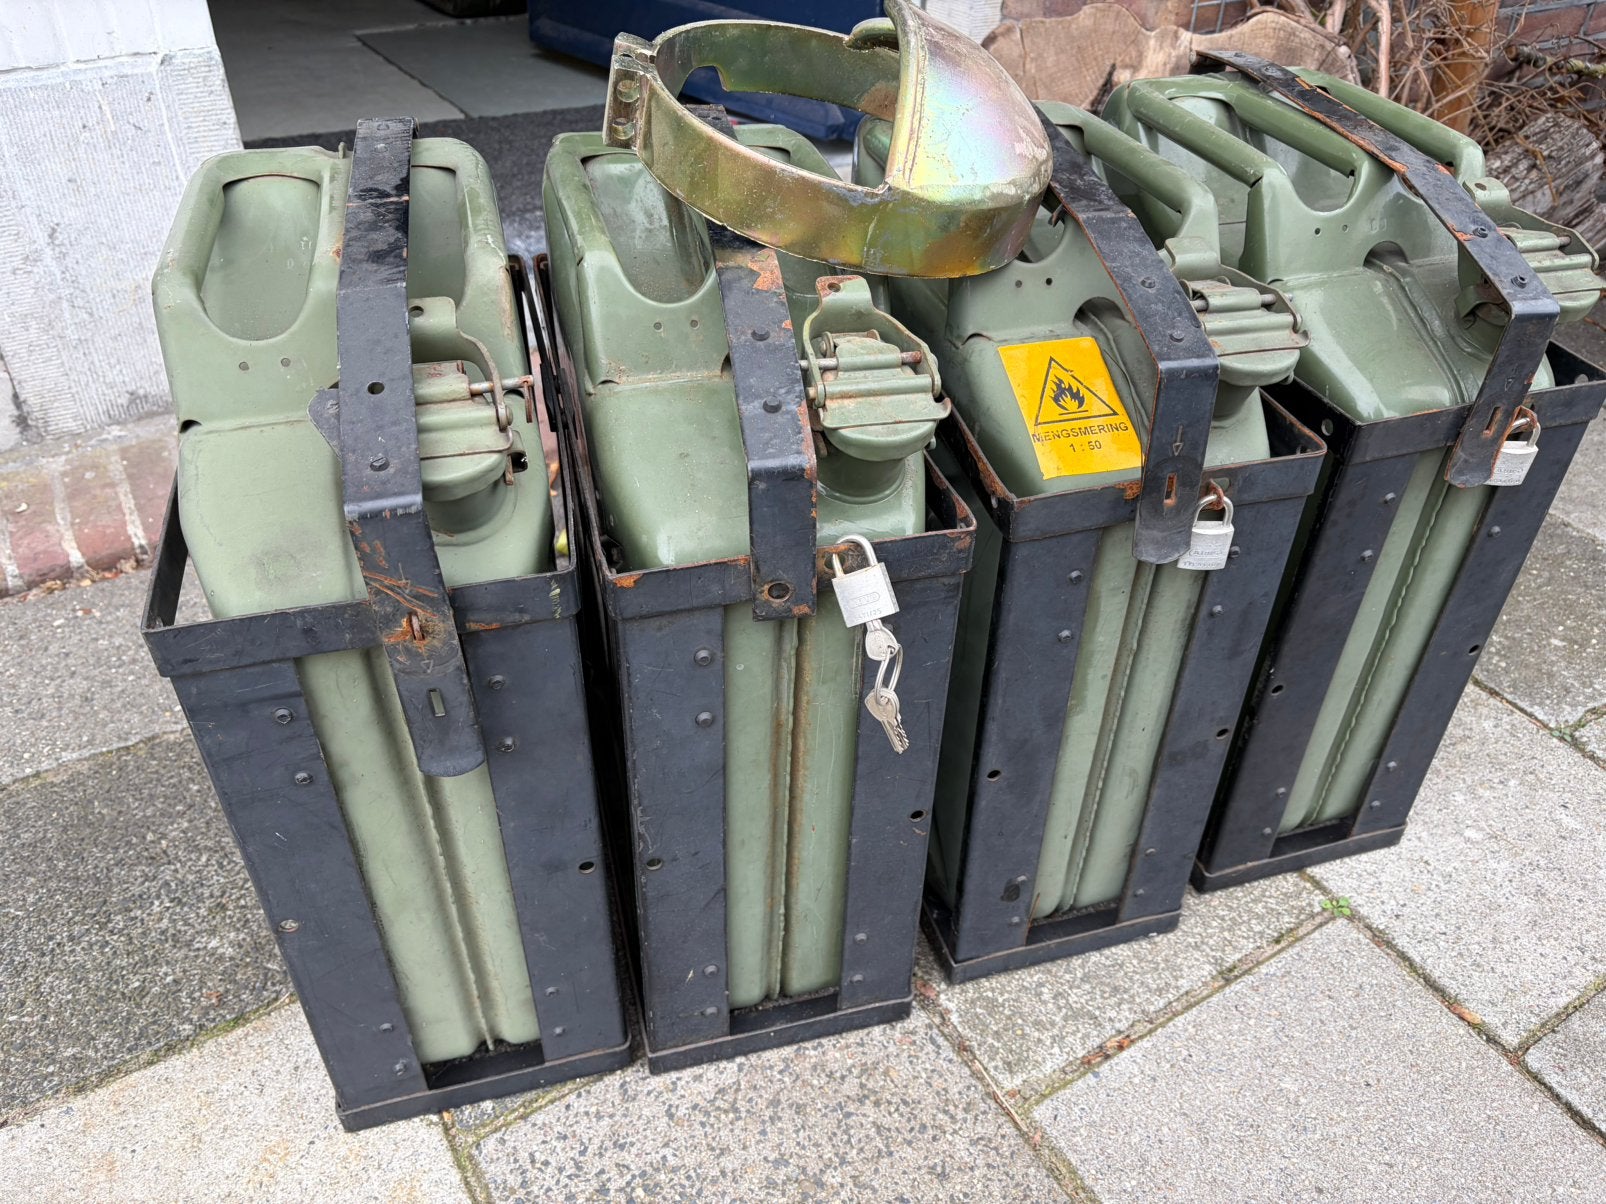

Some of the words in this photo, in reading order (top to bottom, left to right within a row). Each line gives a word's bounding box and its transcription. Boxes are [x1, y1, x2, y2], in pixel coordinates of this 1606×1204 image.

[1032, 422, 1129, 443] MENGSMERING
[1069, 443, 1077, 453] 1
[1087, 440, 1102, 451] 50
